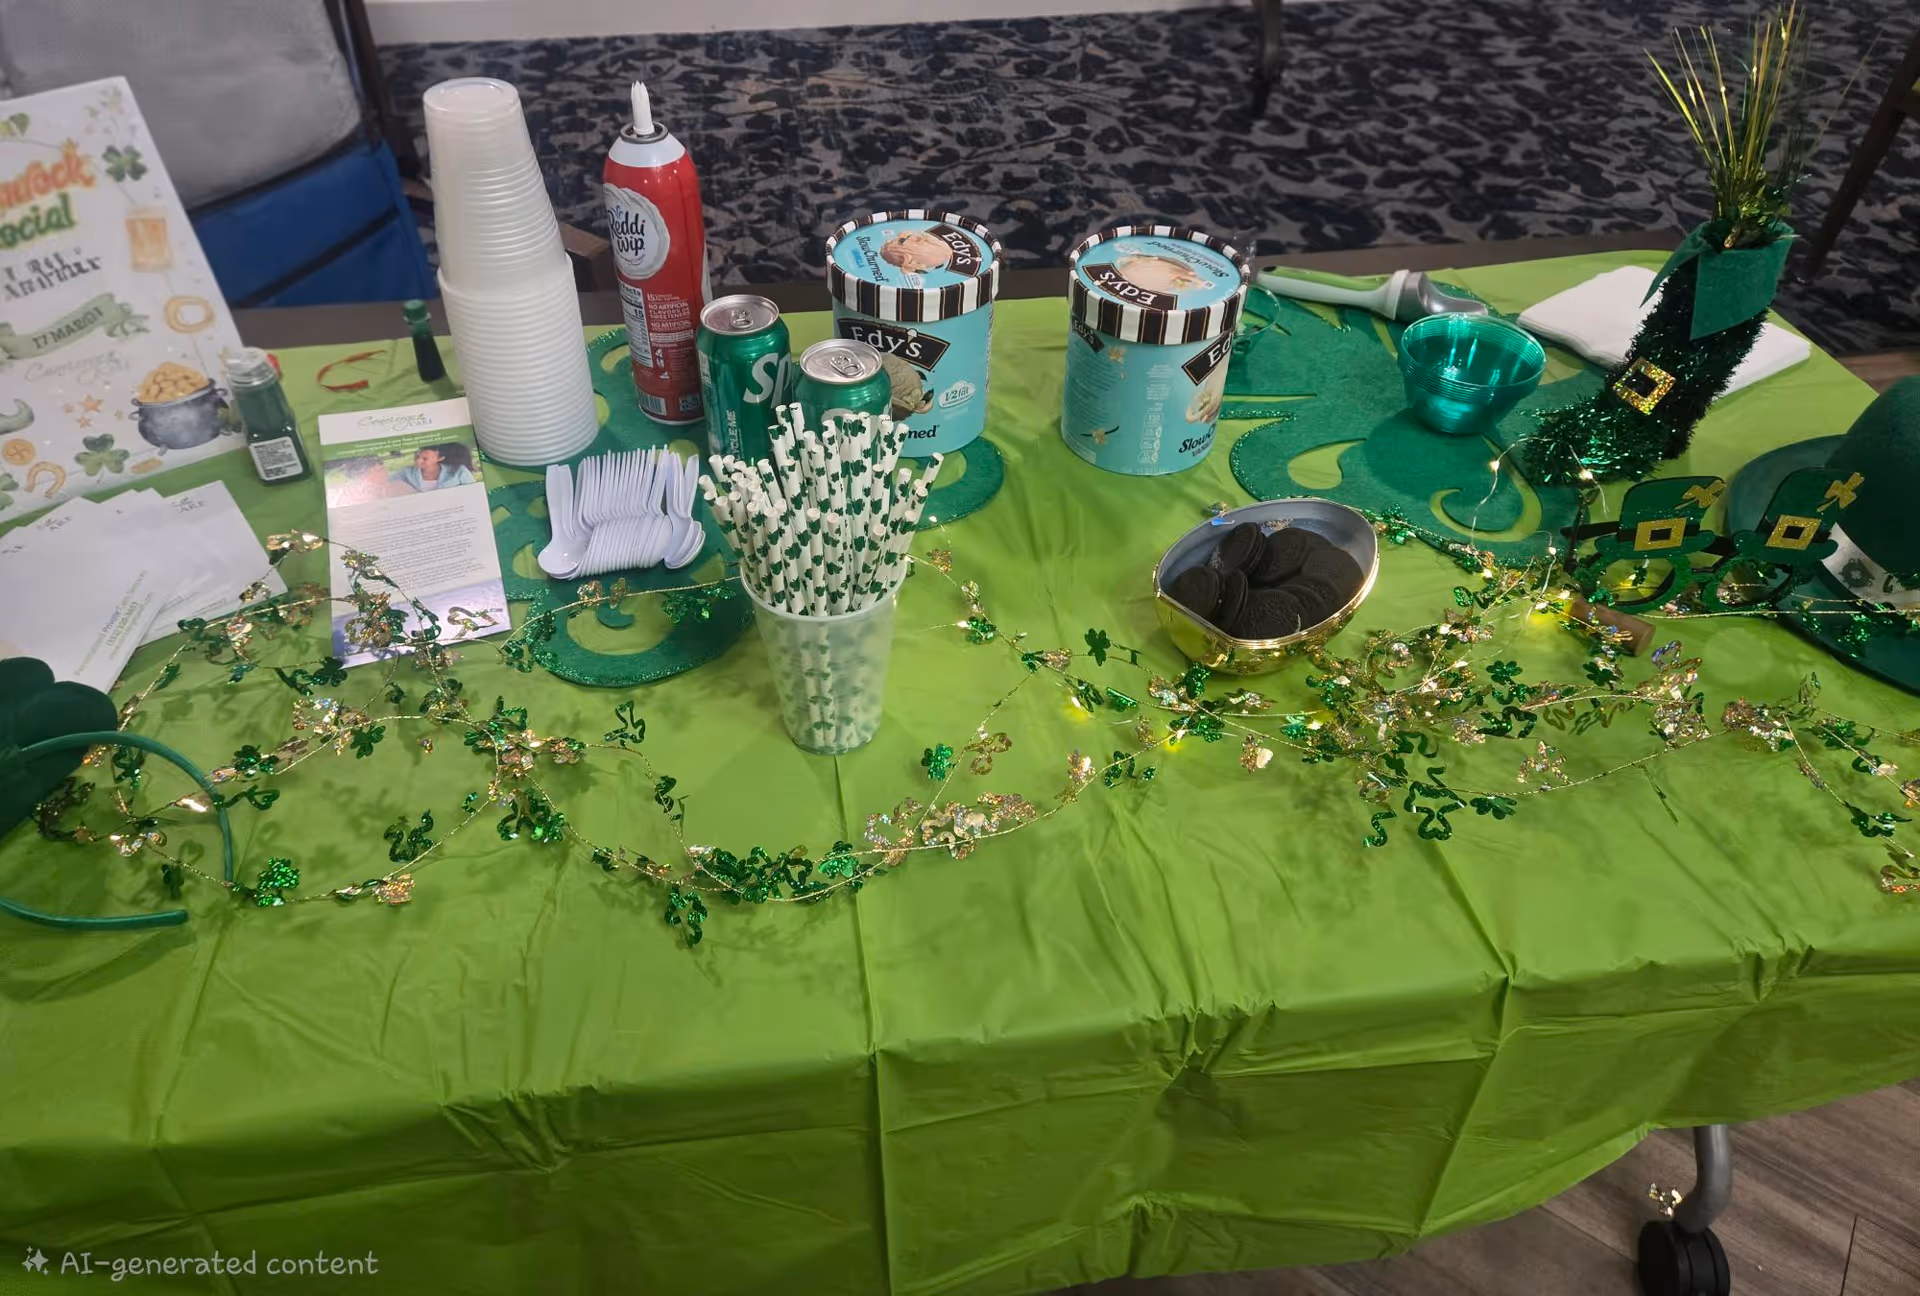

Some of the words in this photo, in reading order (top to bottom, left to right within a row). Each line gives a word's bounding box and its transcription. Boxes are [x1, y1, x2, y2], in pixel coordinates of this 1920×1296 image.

[0, 192, 76, 247] ocial
[608, 209, 646, 239] Reddi
[851, 326, 923, 358] Edy's
